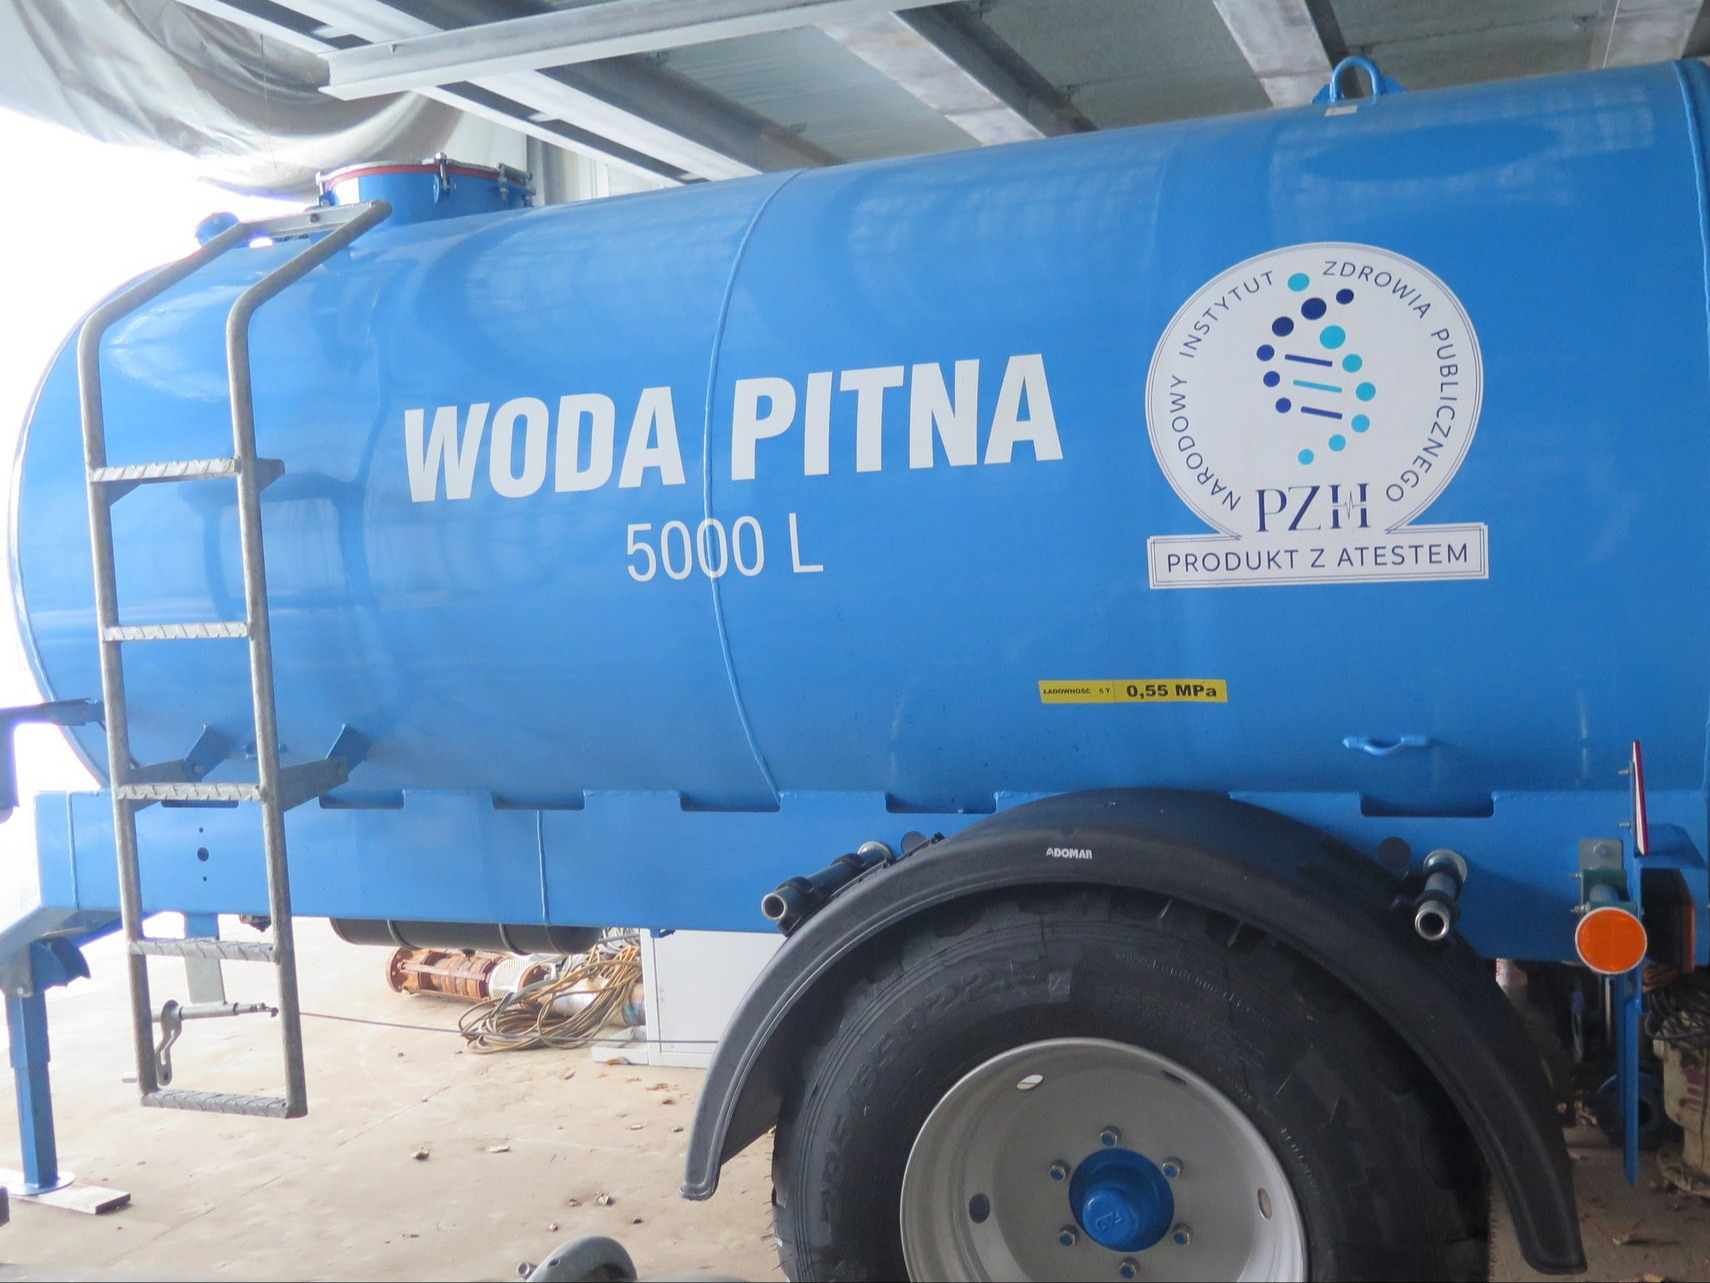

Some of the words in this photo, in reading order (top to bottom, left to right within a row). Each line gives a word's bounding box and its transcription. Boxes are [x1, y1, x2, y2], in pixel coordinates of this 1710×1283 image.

[1178, 270, 1274, 358] INSTYTUT
[1322, 260, 1432, 319] ZDROWIA
[404, 386, 686, 503] WODA
[731, 353, 1063, 481] PITNA
[1169, 374, 1242, 511] NARODOWY
[1385, 327, 1459, 502] PUBLICZNEGO
[1255, 482, 1371, 533] PZH
[626, 515, 765, 583] 5000
[788, 512, 824, 574] L
[1167, 549, 1299, 574] PRODUKT
[1310, 547, 1326, 568] Z
[1337, 543, 1469, 568] ATESTEM
[1126, 684, 1169, 700] 0,55
[1175, 683, 1218, 698] MPa
